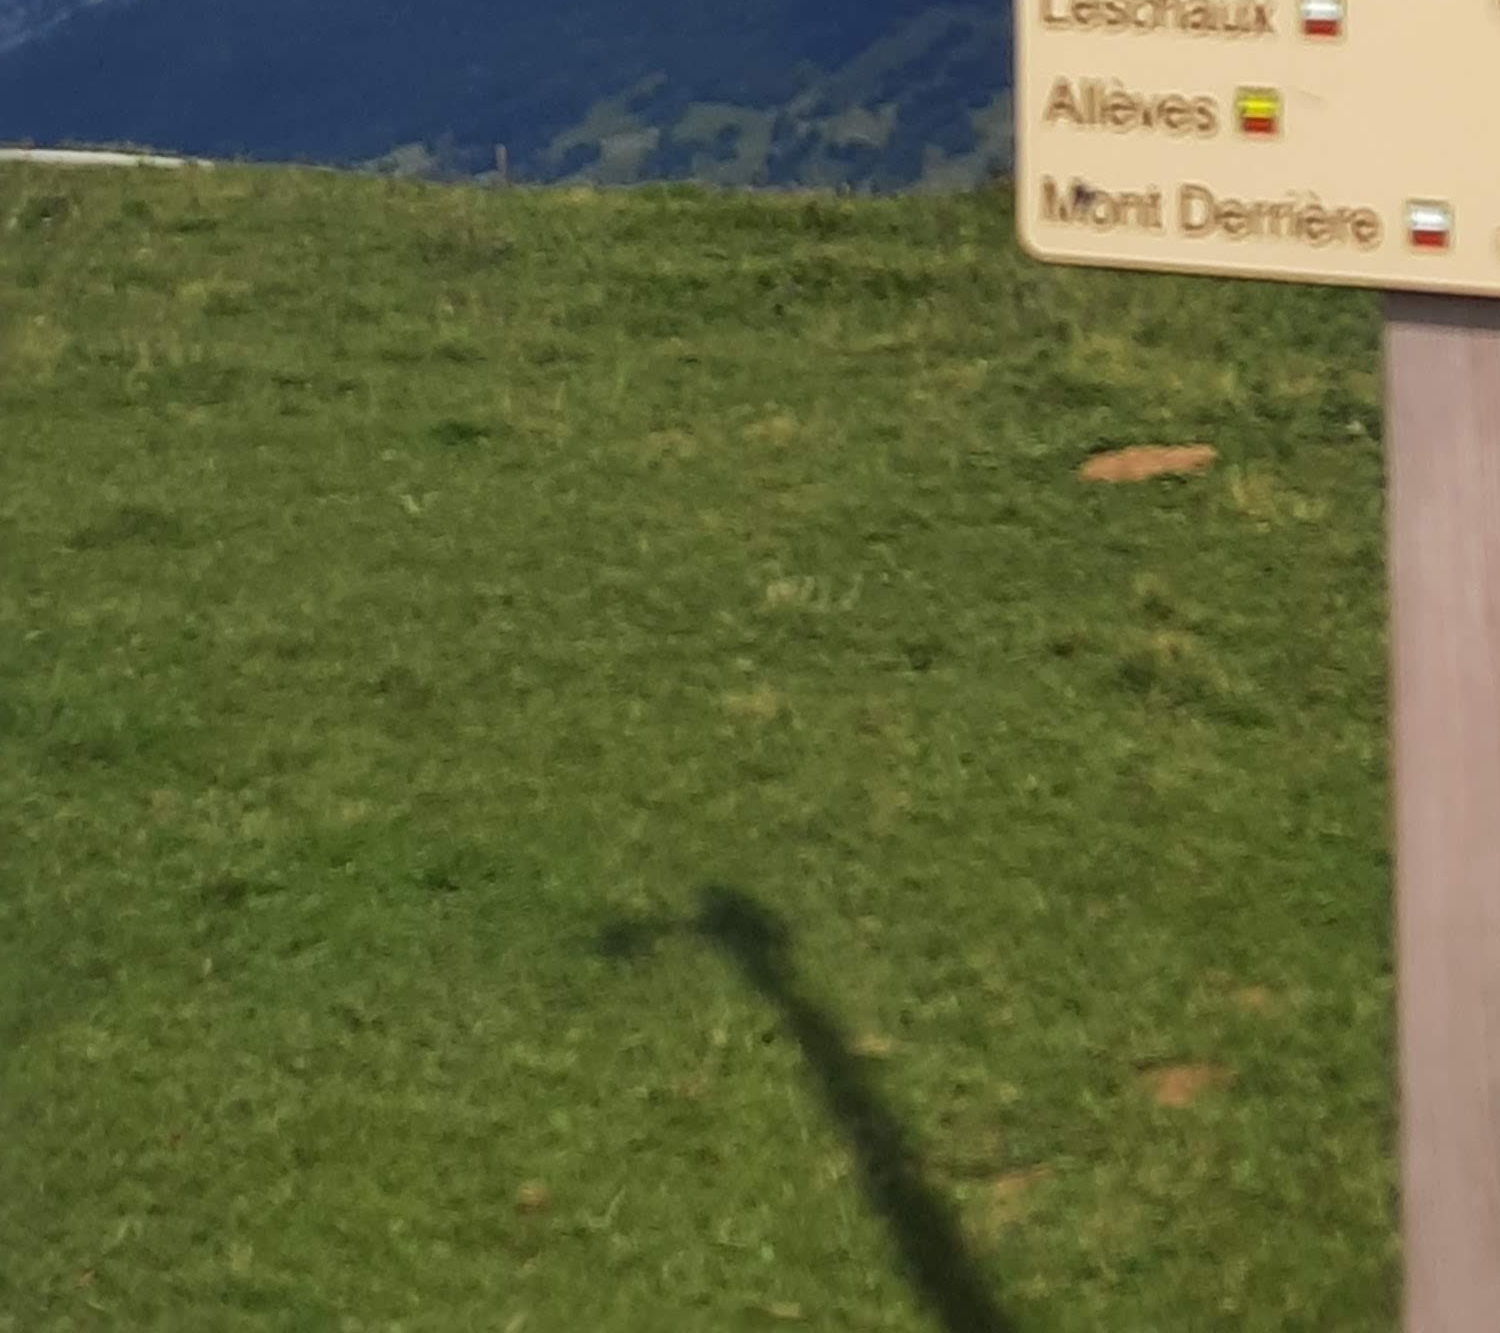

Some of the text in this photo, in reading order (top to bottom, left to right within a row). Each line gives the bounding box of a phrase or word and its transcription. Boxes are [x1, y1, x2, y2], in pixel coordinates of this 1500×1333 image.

[1042, 77, 1219, 137] Allèves
[1042, 177, 1382, 251] Mont Derrière
